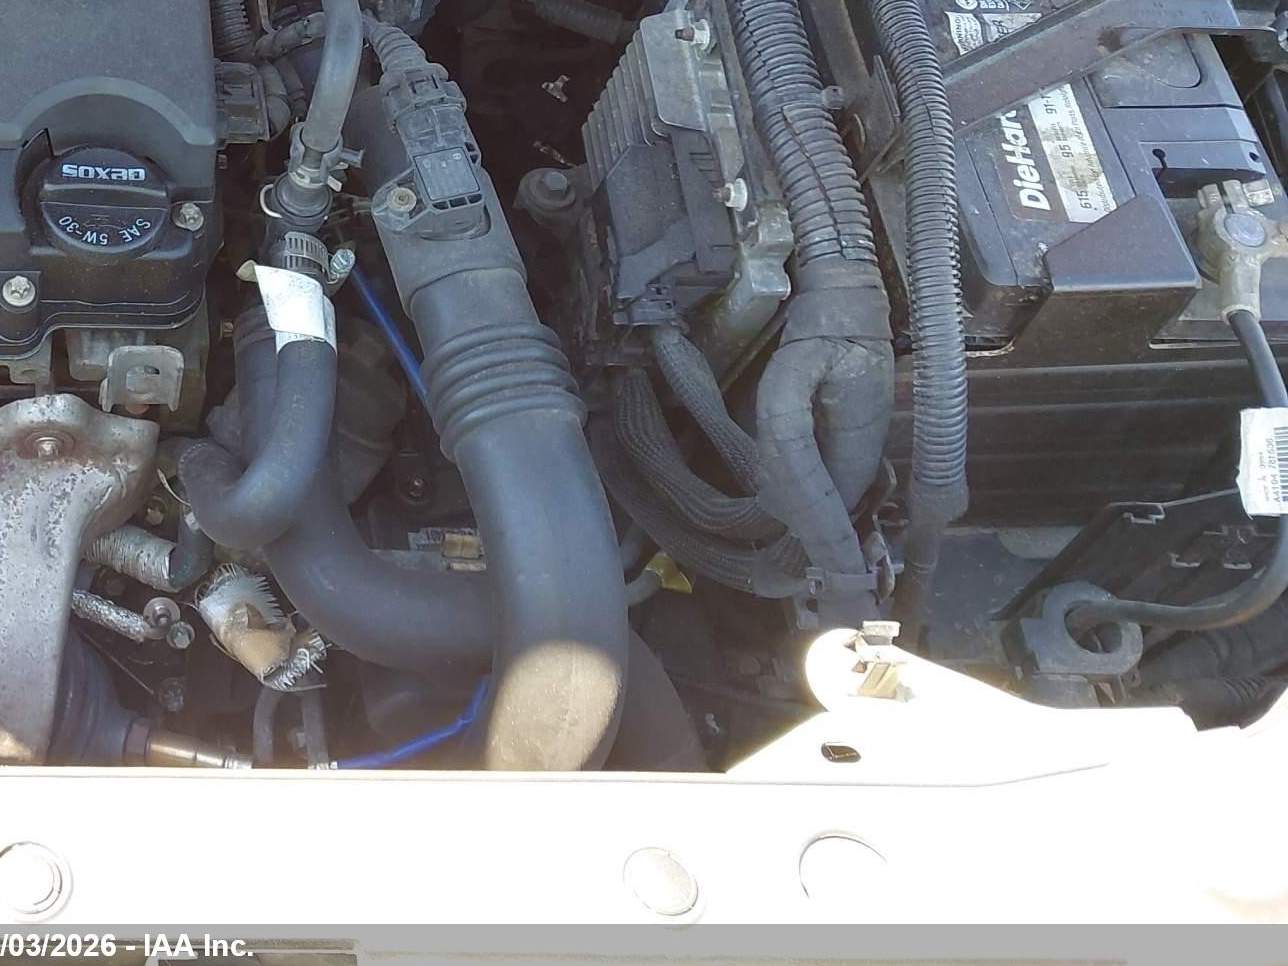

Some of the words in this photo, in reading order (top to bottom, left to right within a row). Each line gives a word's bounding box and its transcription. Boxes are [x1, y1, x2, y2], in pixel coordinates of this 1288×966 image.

[1057, 144, 1073, 158] 95
[1076, 190, 1093, 210] 615
[58, 216, 109, 245] 5W-30
[118, 218, 151, 243] SAE
